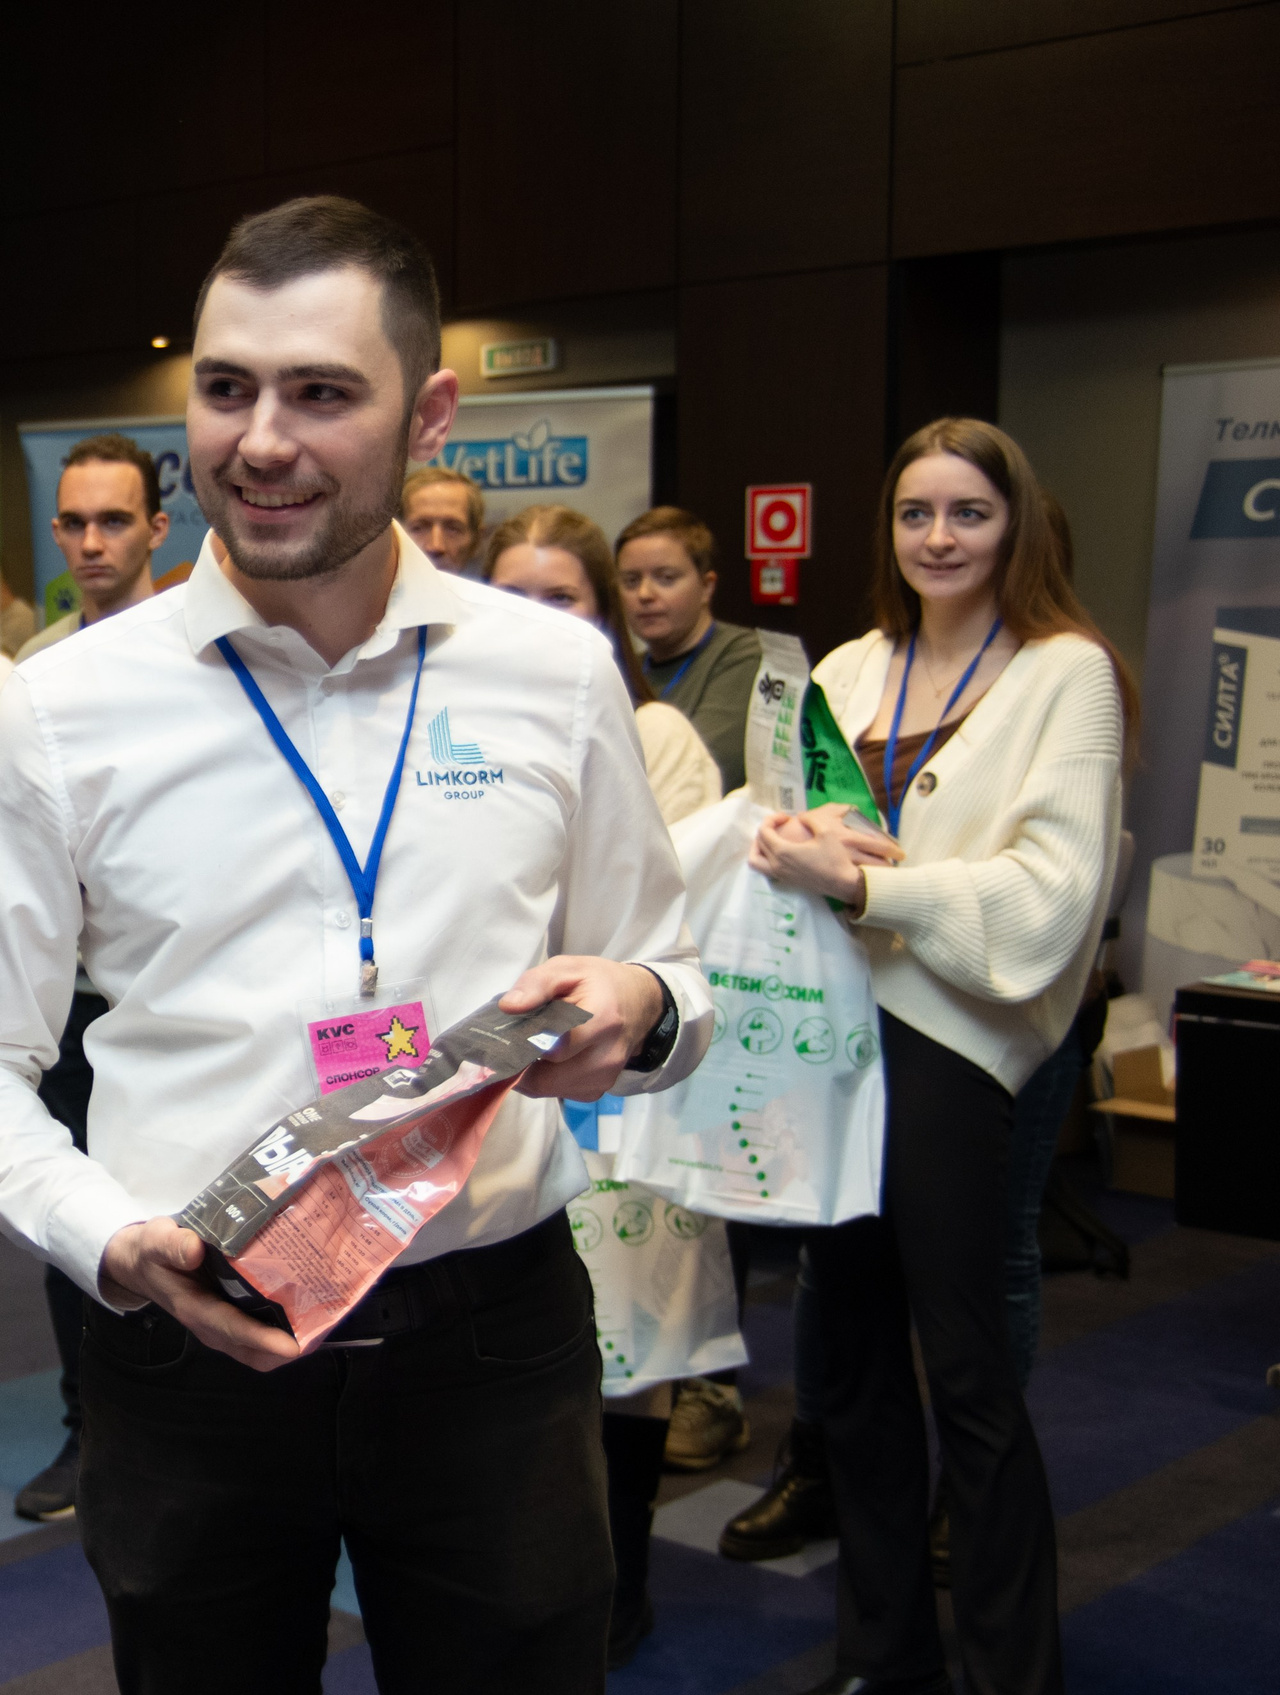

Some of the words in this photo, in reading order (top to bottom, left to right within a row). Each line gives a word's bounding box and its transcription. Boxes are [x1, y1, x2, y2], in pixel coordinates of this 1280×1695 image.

[436, 442, 582, 486] VetLife
[415, 768, 504, 787] LIMKORM
[443, 790, 485, 800] GROUP
[1202, 837, 1226, 855] 30
[316, 1023, 355, 1041] KVC
[325, 1067, 381, 1085] СПОНСОР
